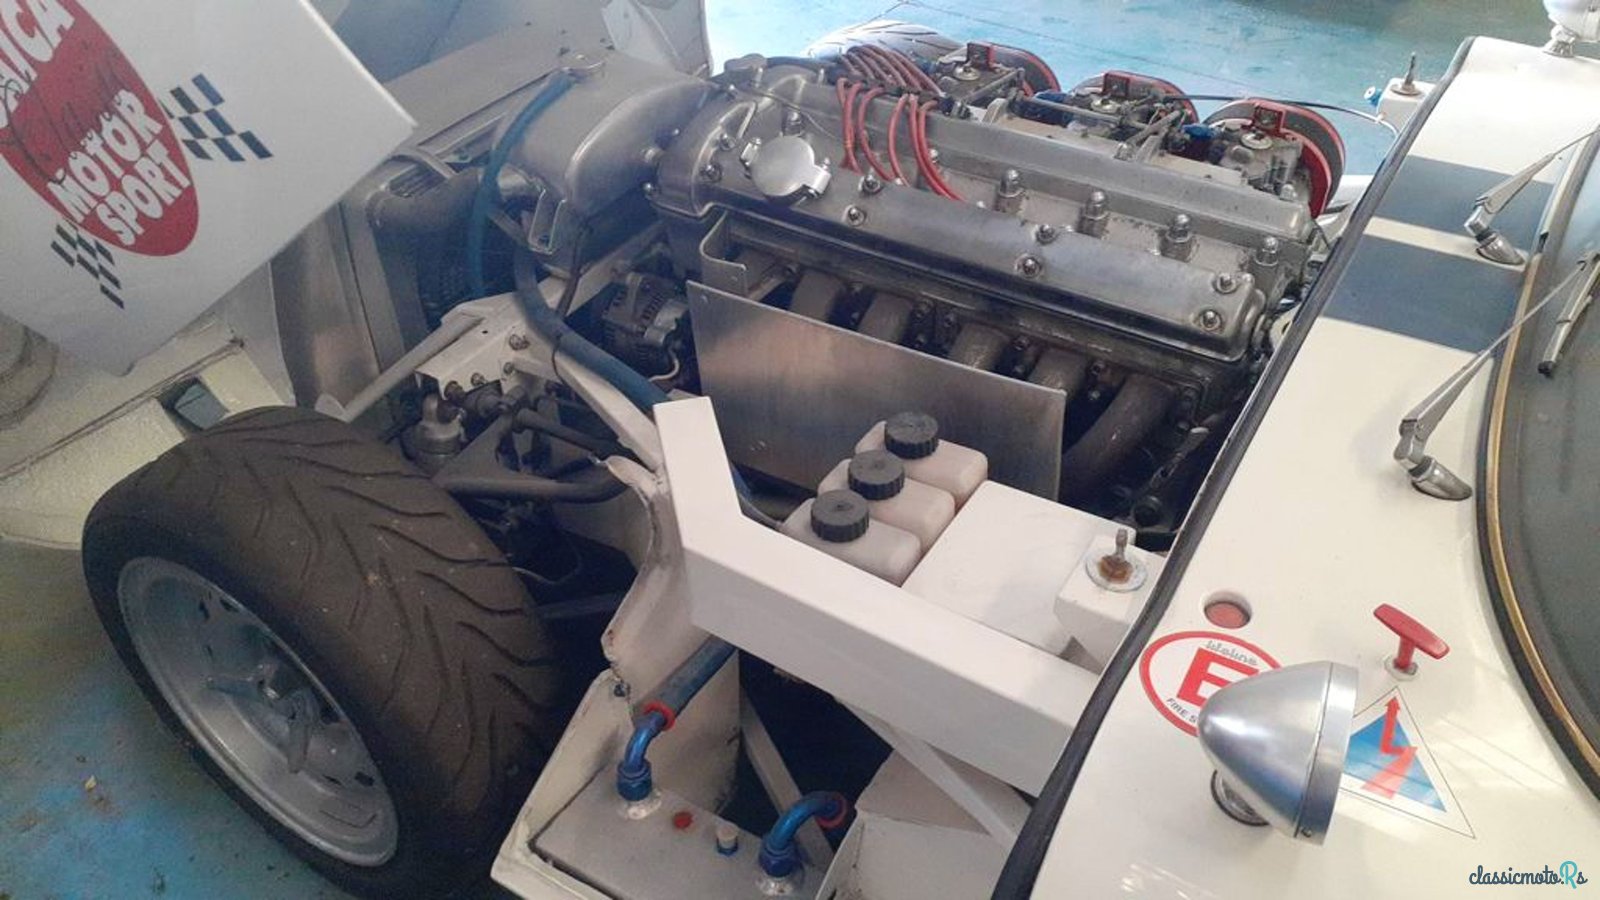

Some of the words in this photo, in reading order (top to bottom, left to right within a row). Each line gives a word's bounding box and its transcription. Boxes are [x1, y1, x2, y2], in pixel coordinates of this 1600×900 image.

[47, 89, 164, 223] MOTOR
[96, 138, 192, 246] SPORT
[1177, 647, 1260, 707] E
